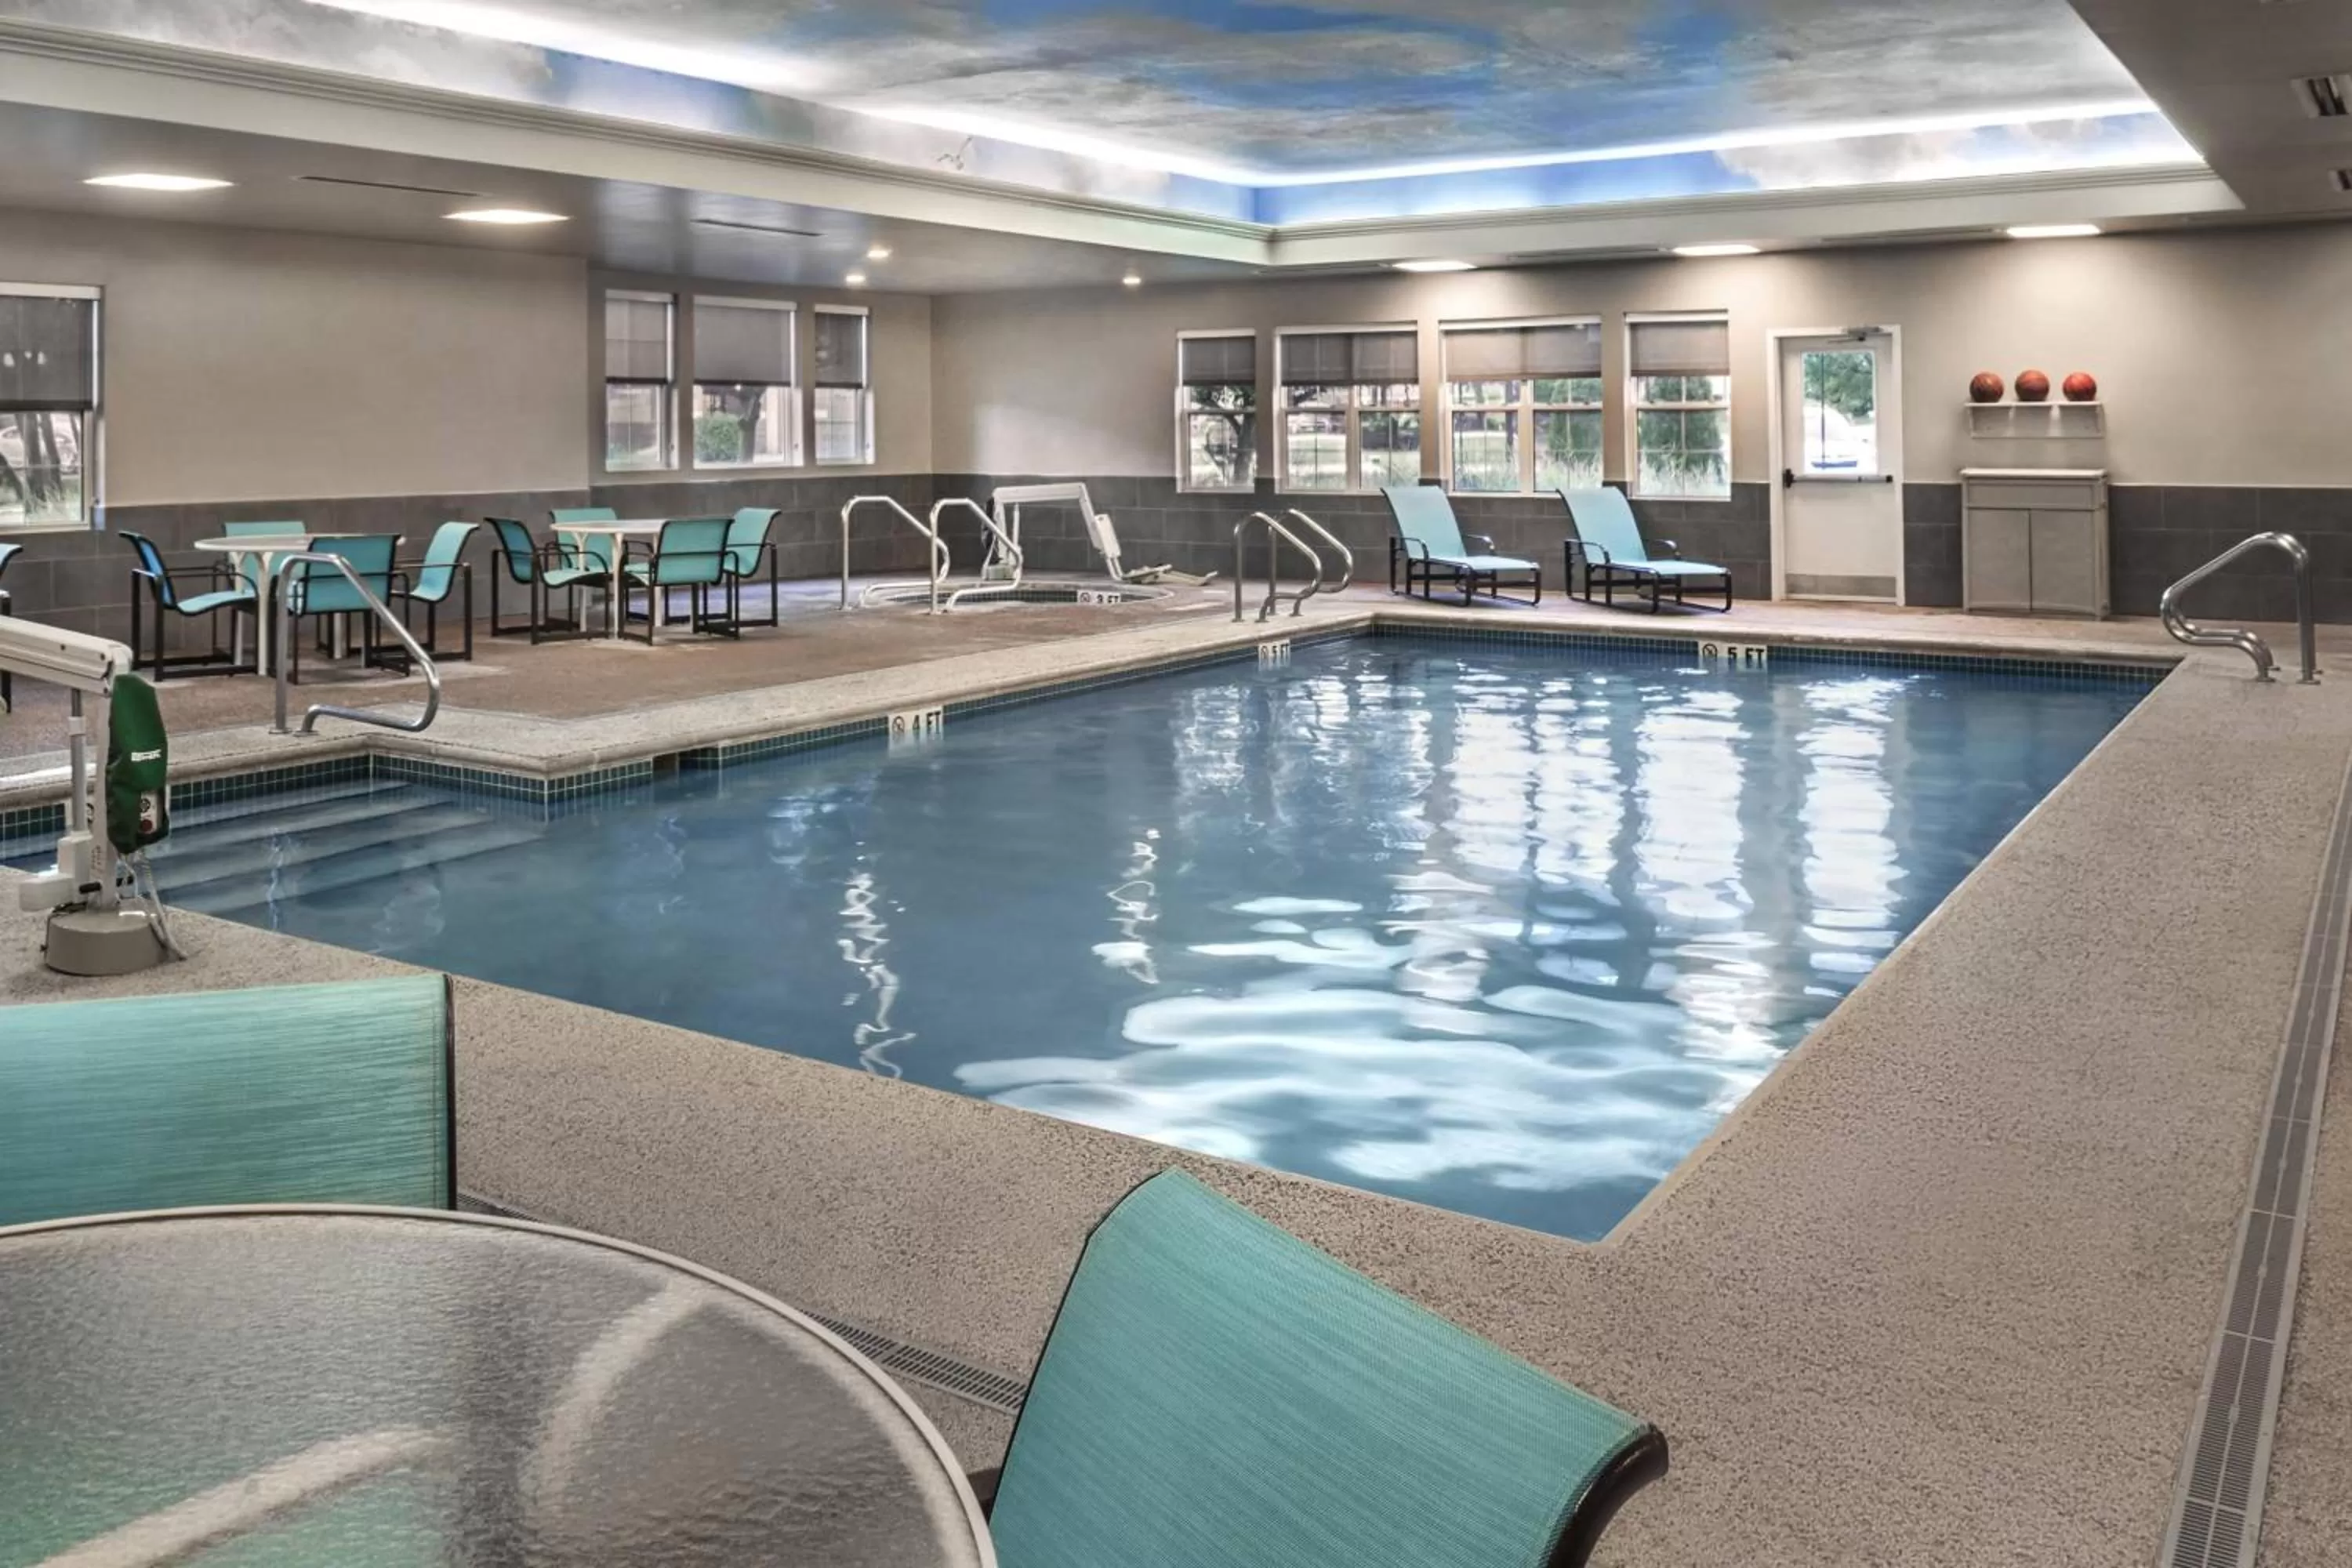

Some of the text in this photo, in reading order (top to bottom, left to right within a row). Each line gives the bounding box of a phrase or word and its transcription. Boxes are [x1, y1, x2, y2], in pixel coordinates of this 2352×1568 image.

[1727, 647, 1764, 669] 5 FT
[927, 710, 941, 735] FT
